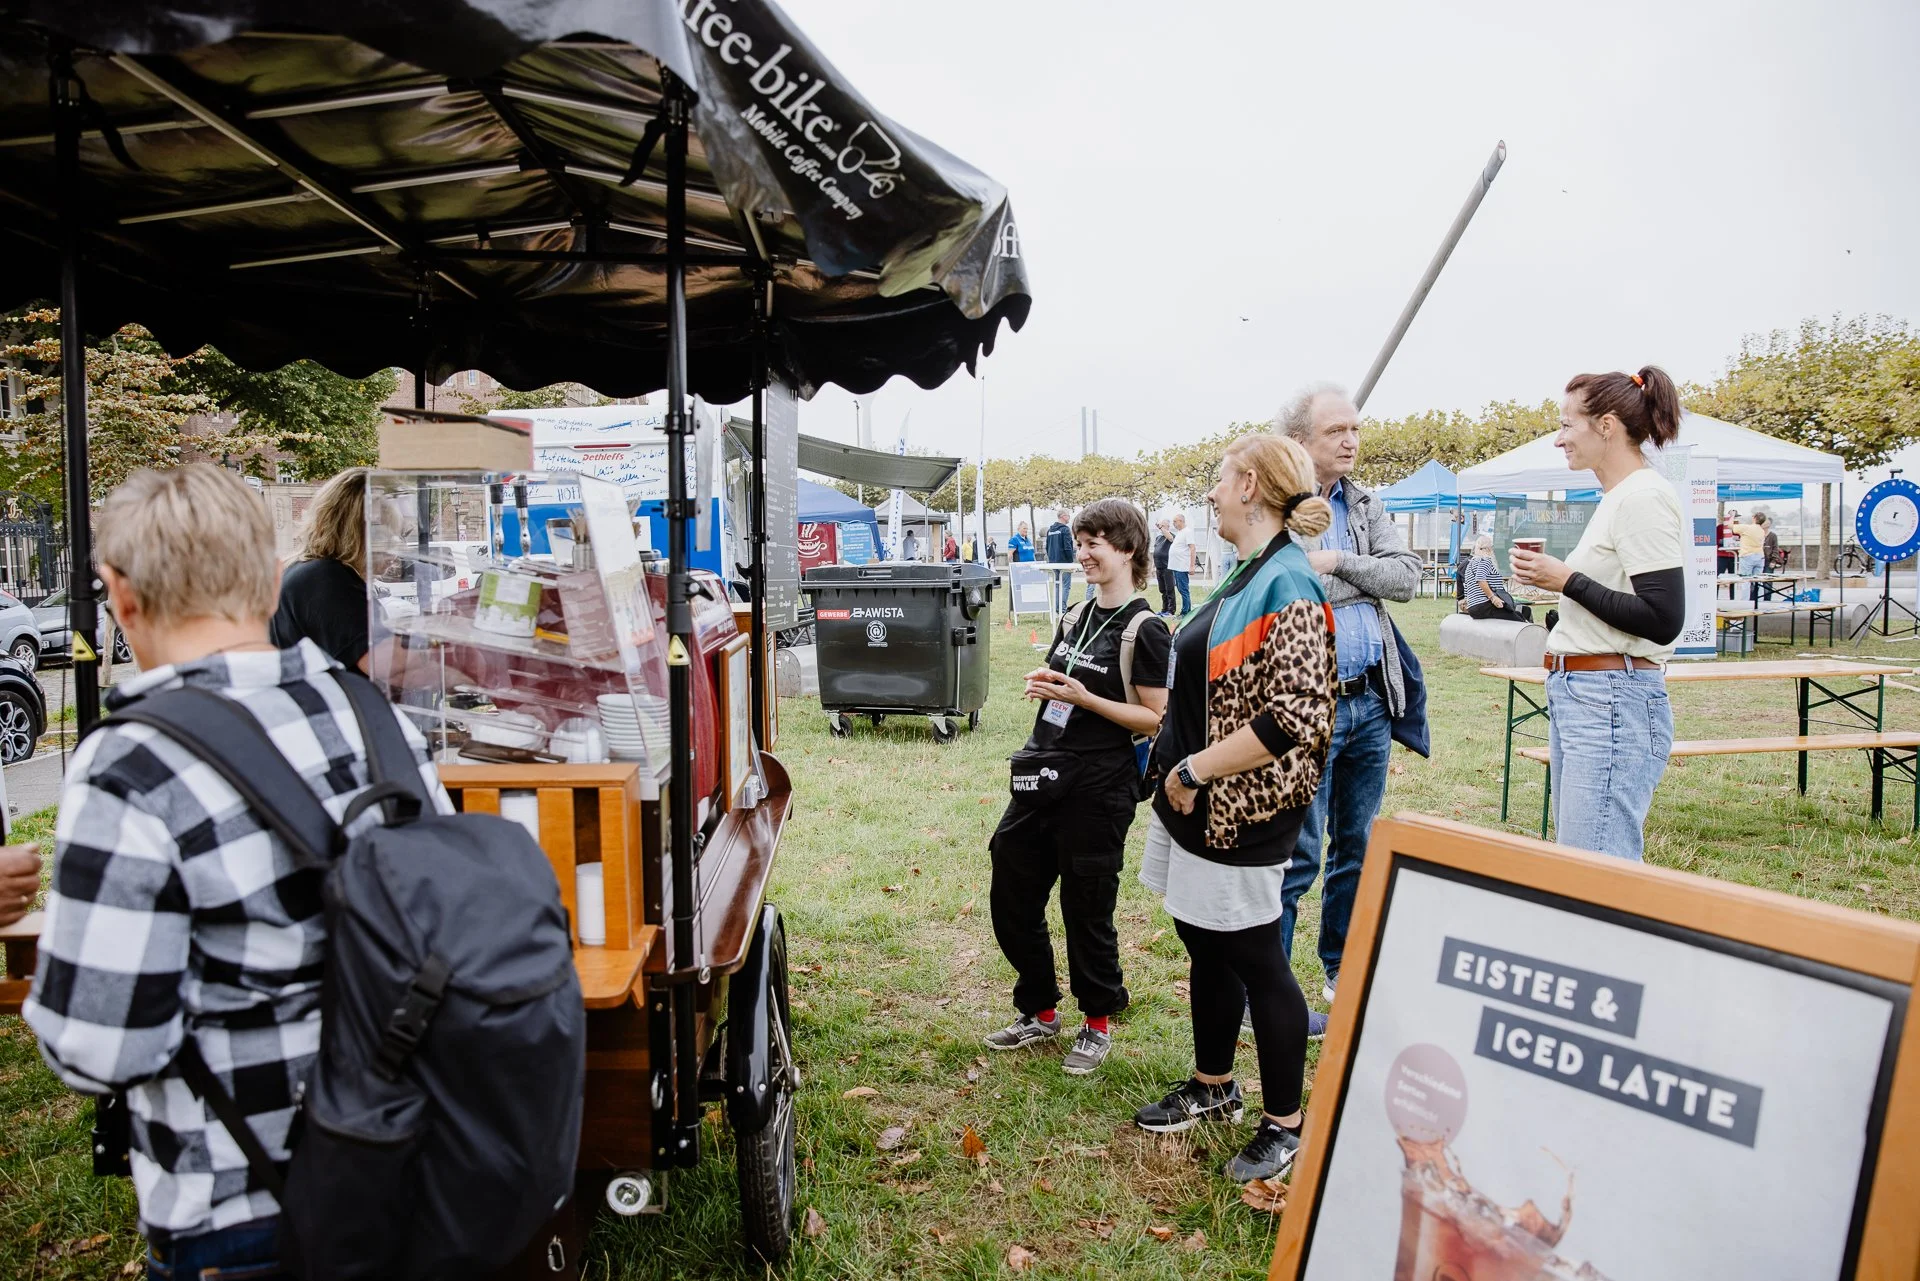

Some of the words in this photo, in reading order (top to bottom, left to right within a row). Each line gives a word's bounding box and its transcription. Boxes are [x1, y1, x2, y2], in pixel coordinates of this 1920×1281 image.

[740, 103, 789, 149] Mobile
[784, 144, 823, 182] Coffee
[819, 176, 864, 220] Company
[582, 452, 625, 462] Dethleffs
[1695, 556, 1712, 564] spiel
[864, 607, 905, 618] AWISTA
[1051, 701, 1069, 712] CREW
[1012, 781, 1039, 791] WALK
[1452, 951, 1579, 1010] EISTEE
[1590, 986, 1619, 1022] &
[1491, 1022, 1584, 1076] ICED
[1599, 1053, 1737, 1129] LATTE
